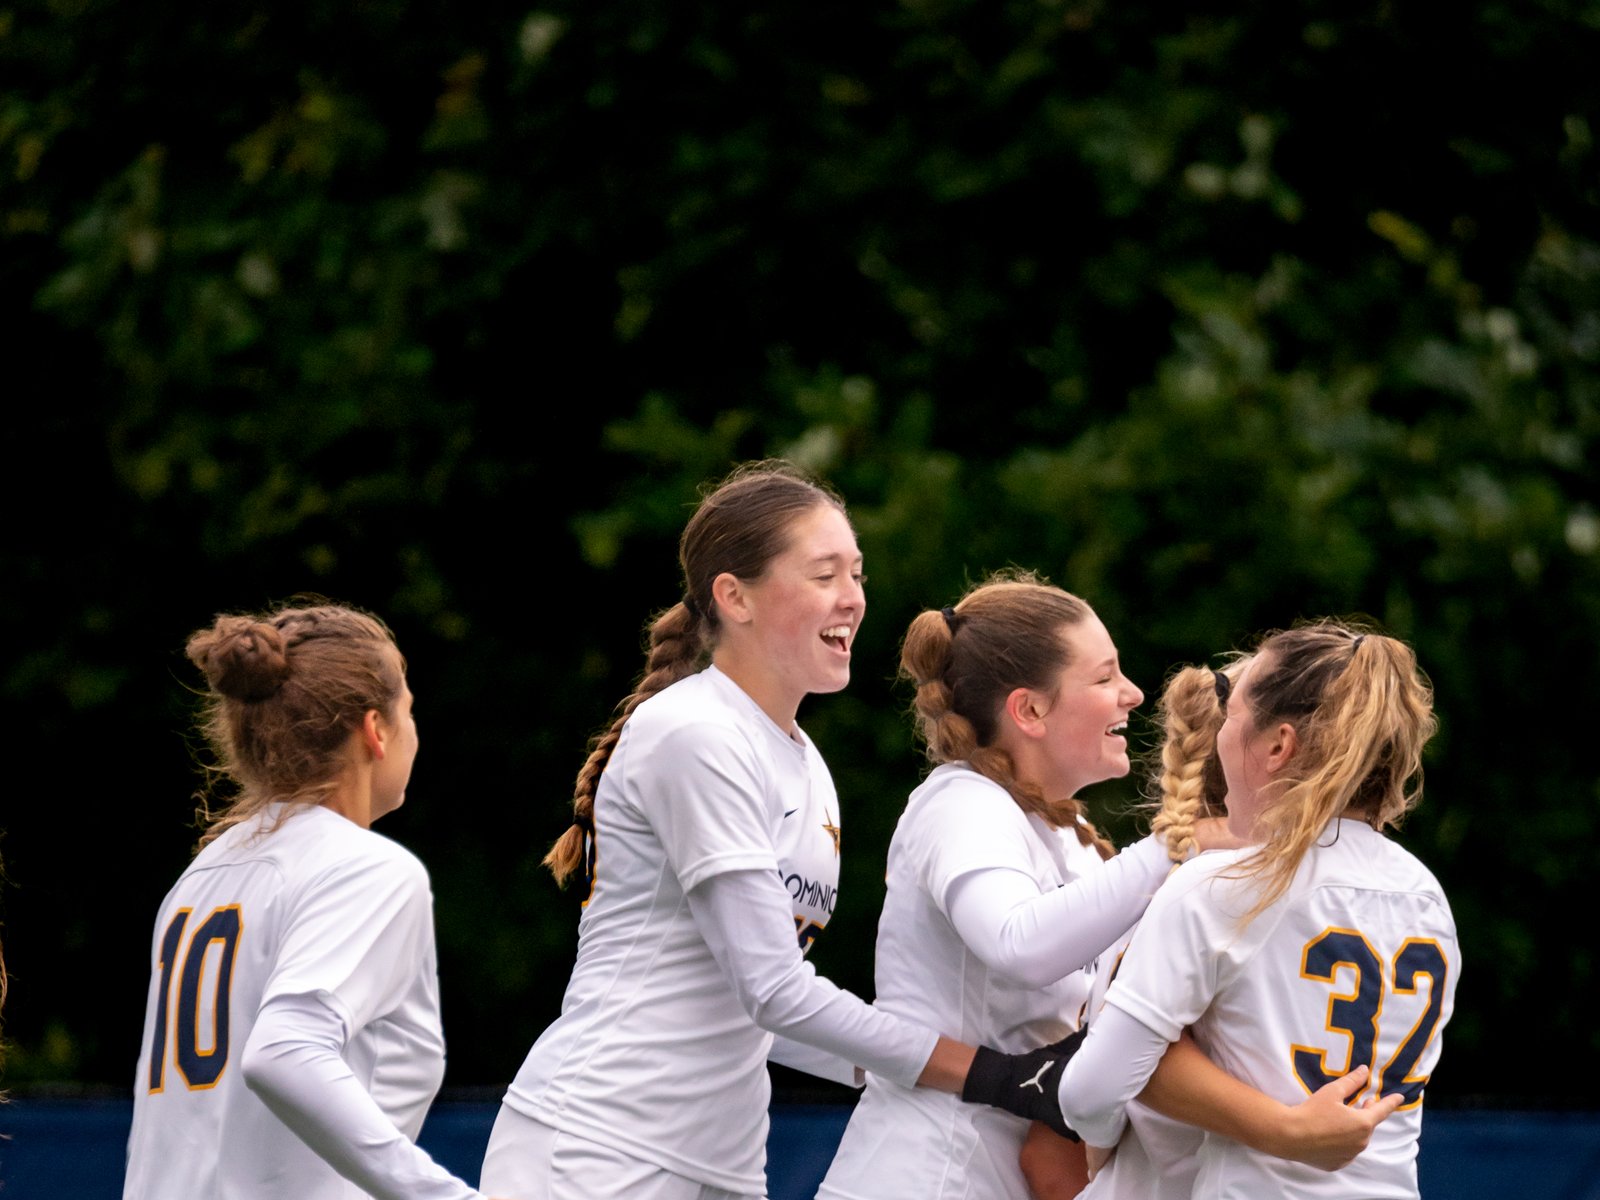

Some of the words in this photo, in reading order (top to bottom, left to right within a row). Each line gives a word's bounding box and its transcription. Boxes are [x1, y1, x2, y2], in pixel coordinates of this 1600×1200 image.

[778, 869, 837, 915] OMINIC
[148, 903, 244, 1095] 10
[1290, 926, 1449, 1111] 32
